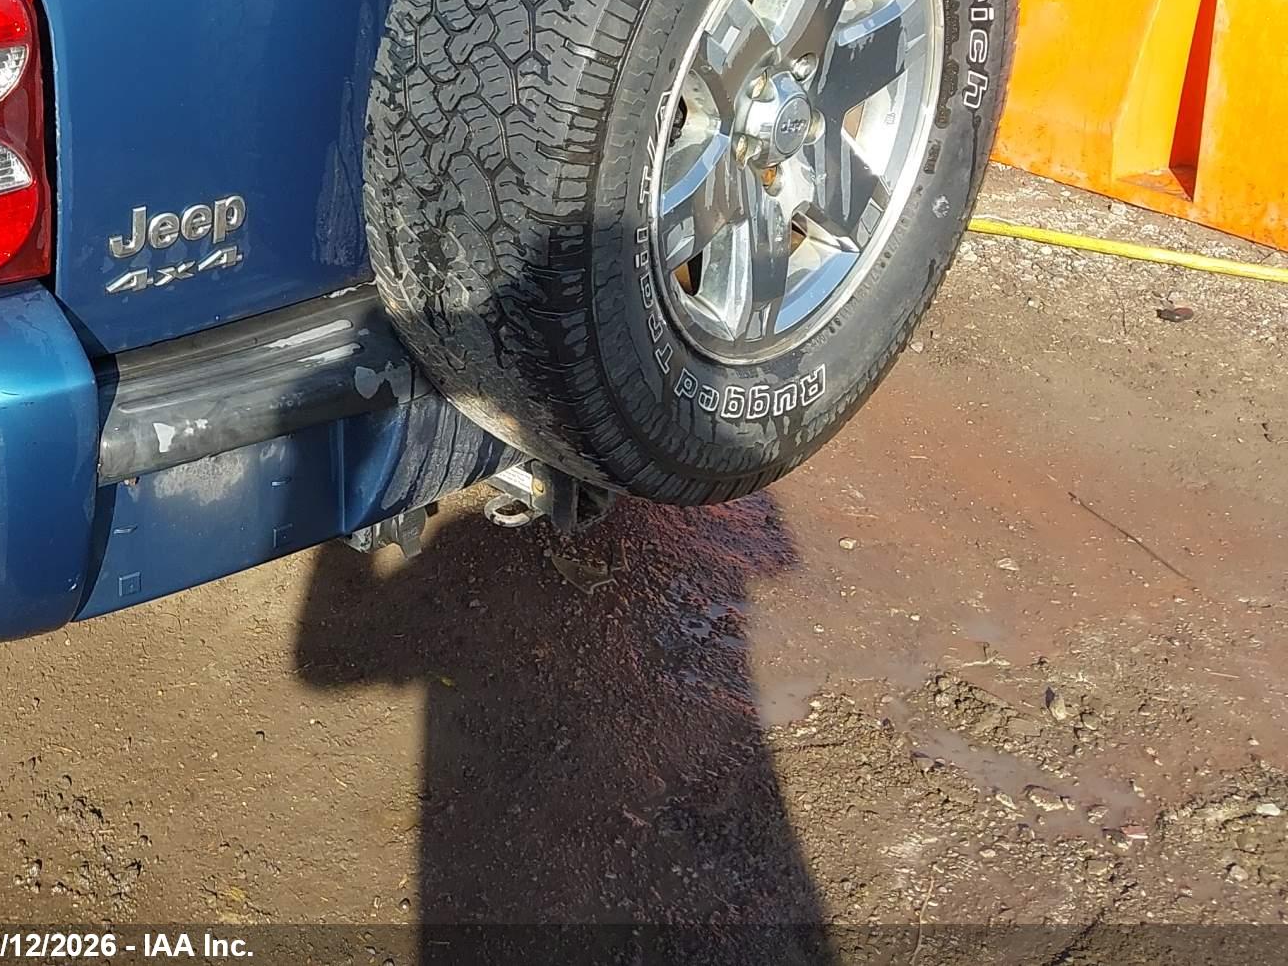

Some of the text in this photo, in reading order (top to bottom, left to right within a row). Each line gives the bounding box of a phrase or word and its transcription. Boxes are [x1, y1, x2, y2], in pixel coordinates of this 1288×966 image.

[108, 194, 247, 258] Jeep
[634, 225, 674, 374] Trail
[674, 363, 826, 420] Rugged
